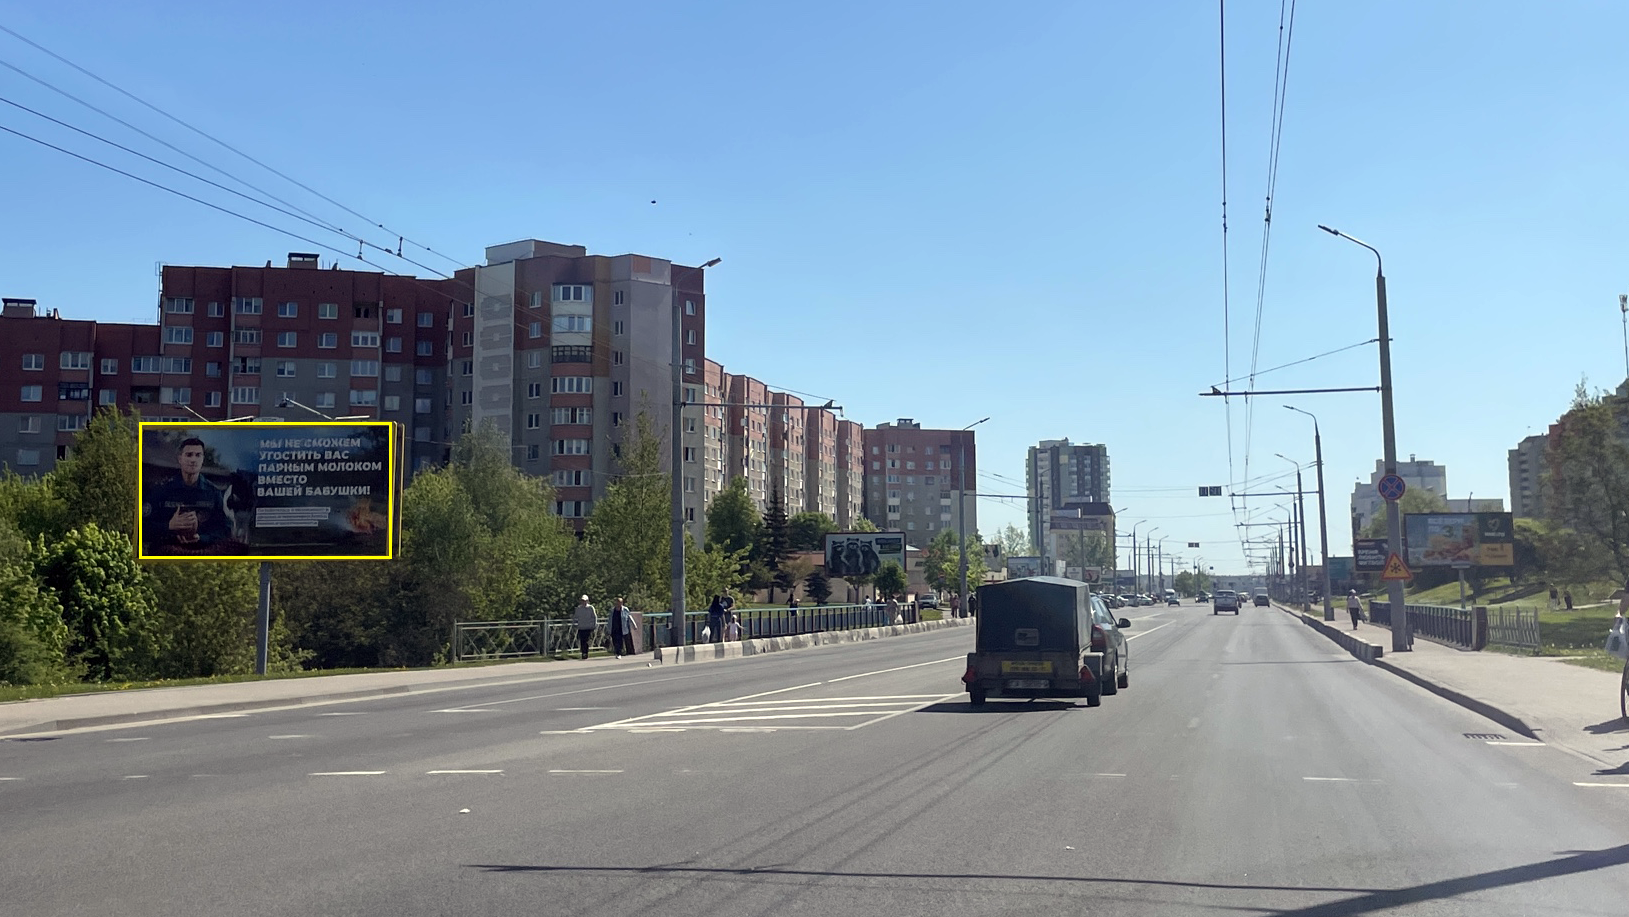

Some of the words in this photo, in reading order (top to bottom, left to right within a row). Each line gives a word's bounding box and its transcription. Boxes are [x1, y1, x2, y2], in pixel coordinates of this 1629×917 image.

[259, 439, 282, 449] МЫ
[284, 439, 301, 448] НЕ
[304, 438, 361, 448] СМОЖЕМ
[259, 451, 321, 461] УГОСТИТЬ
[324, 450, 350, 460] ВАС
[258, 462, 314, 473] ПАРНЫМ
[317, 461, 382, 472] МОЛОКОМ
[257, 475, 308, 485] ВМЕСТО
[257, 485, 302, 497] ВАШЕЙ
[305, 485, 371, 496] БАБУШКИ!
